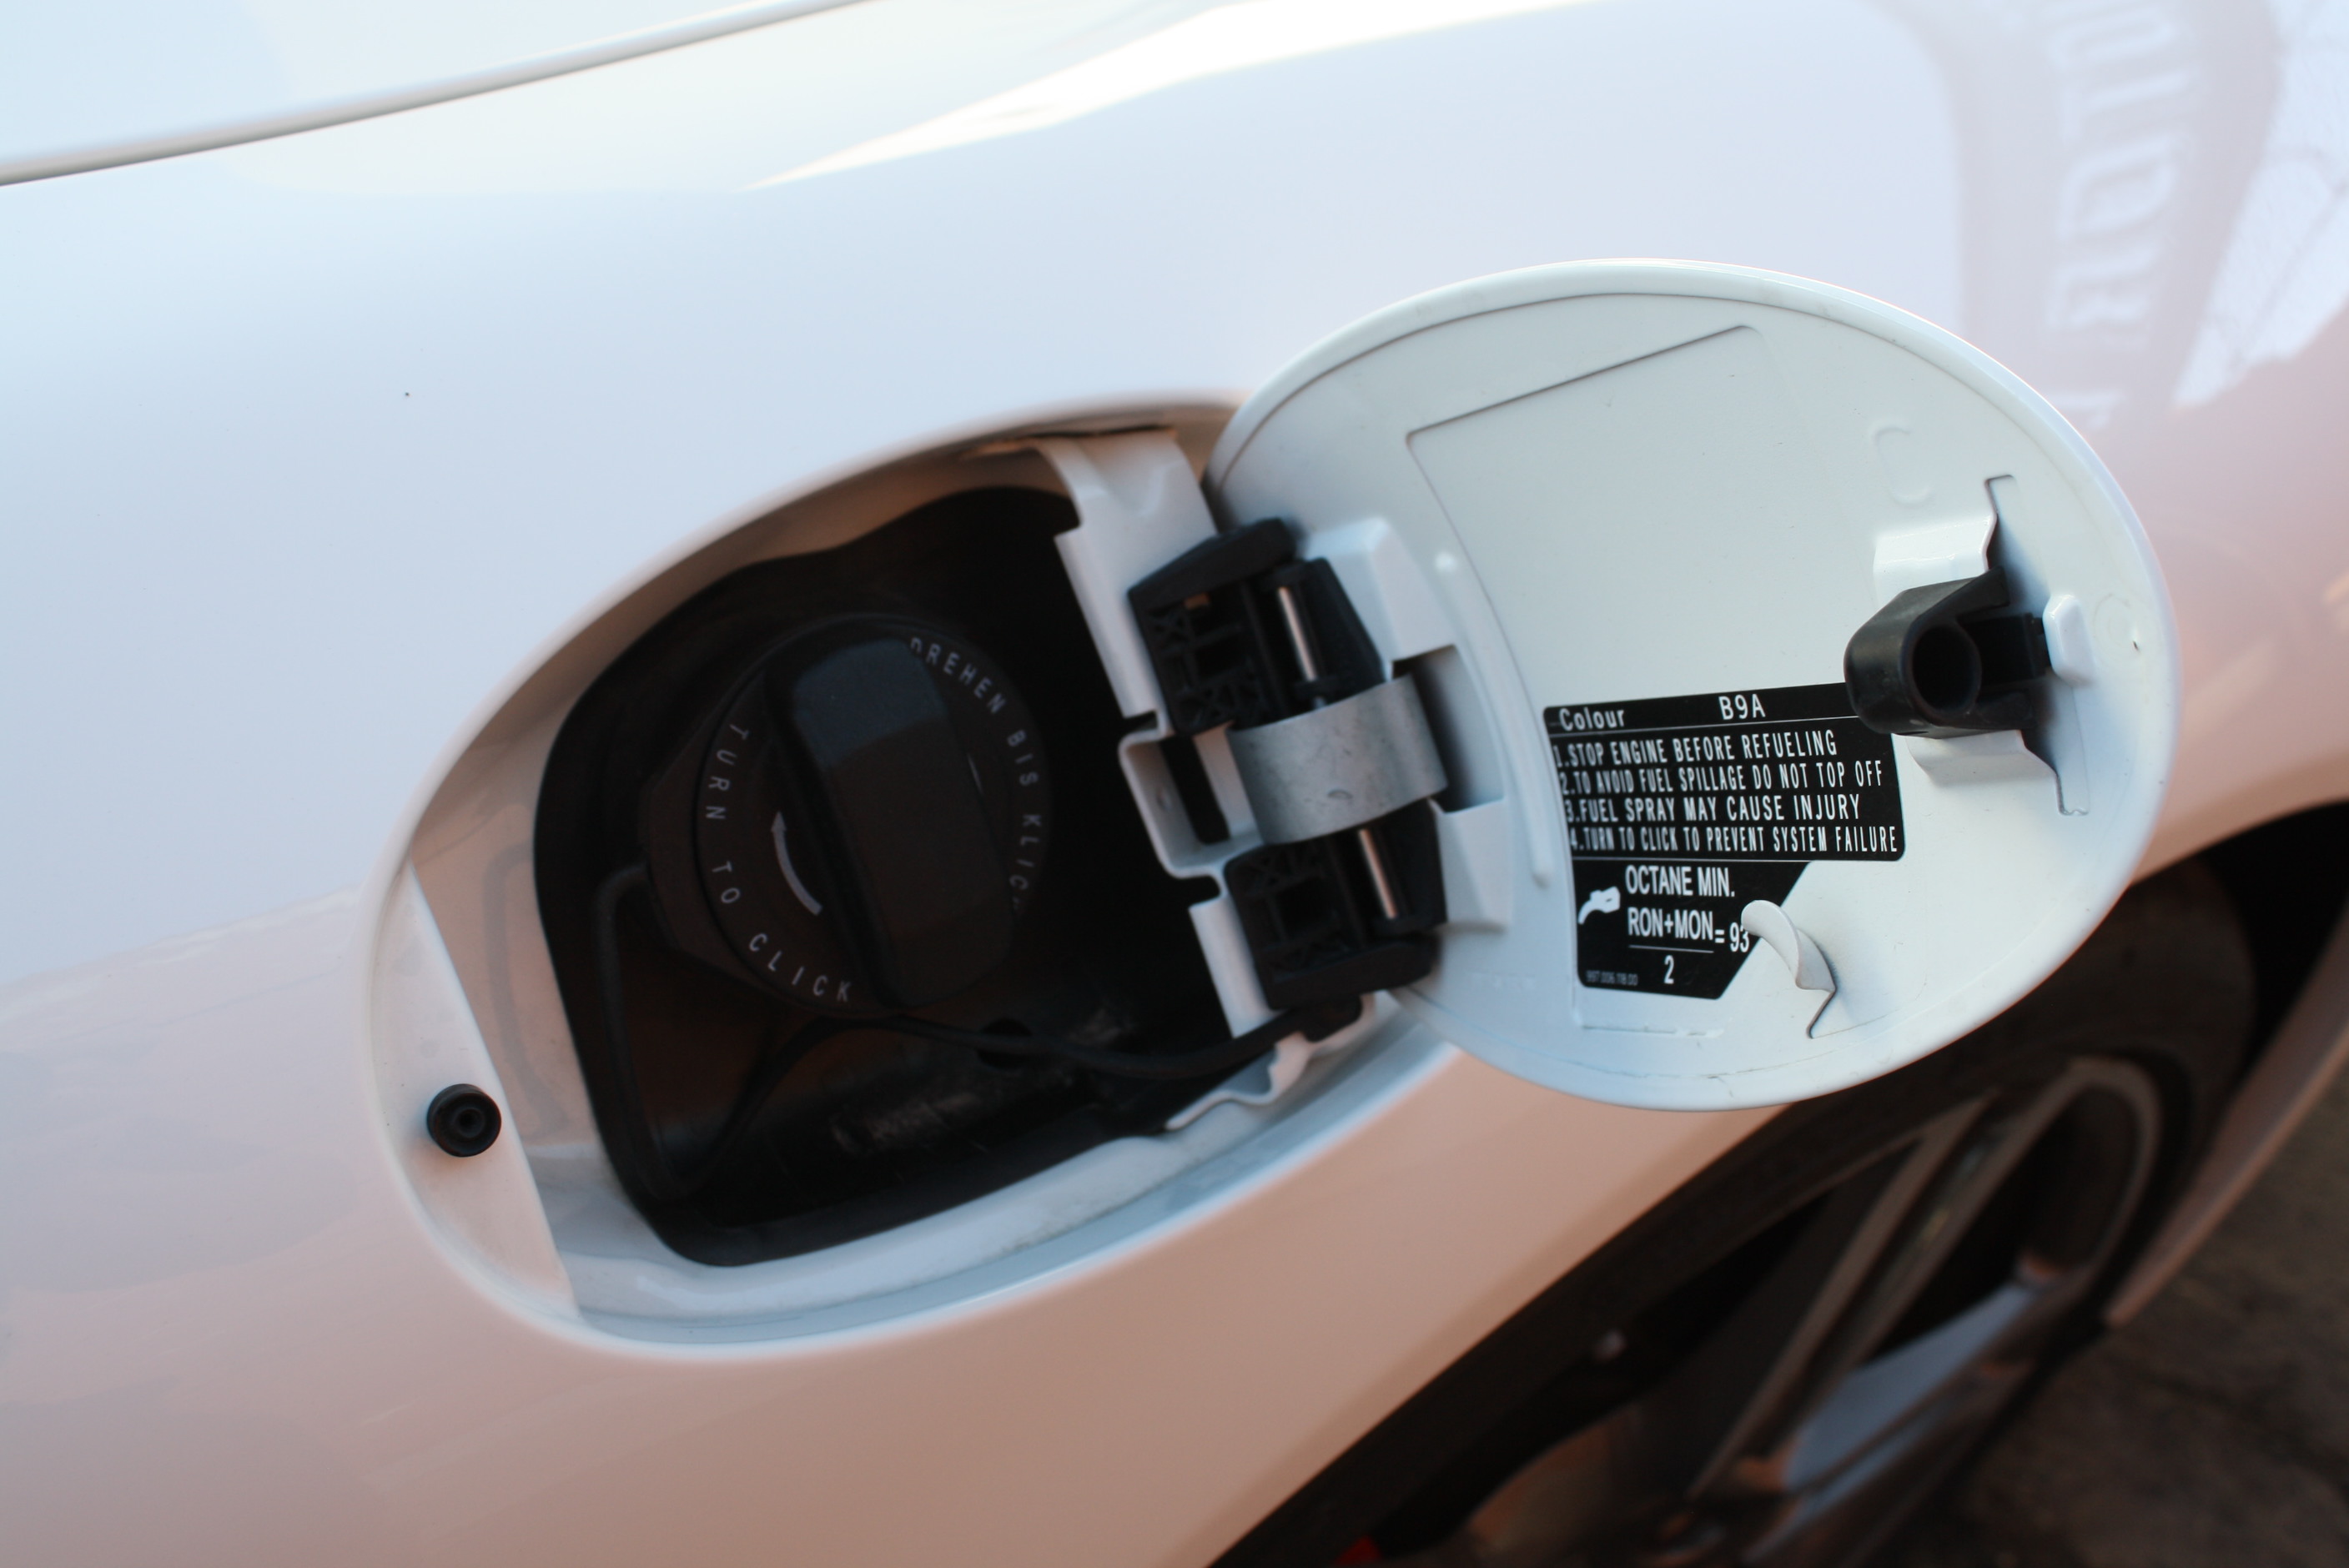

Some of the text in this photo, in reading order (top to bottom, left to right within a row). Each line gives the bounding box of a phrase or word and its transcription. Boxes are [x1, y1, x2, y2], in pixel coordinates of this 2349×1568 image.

[1558, 694, 1766, 731] Colour B9A
[1006, 730, 1040, 787] BIS
[1610, 739, 1667, 766] ENGINE
[1672, 736, 1735, 762] BEFORE
[1742, 729, 1837, 760] REFUELING
[1596, 769, 1634, 794] AVOID
[1639, 768, 1673, 792] FUEL
[1678, 765, 1746, 792] SPILLAGE
[1752, 764, 1772, 790] DO
[1779, 762, 1808, 789] NOT
[1816, 761, 1844, 788] TOP
[1855, 760, 1882, 787] OFF
[1624, 797, 1675, 822] SPRAY
[1683, 797, 1717, 822] MAY
[1726, 795, 1785, 822] CAUSE
[1793, 794, 1859, 821] INJURY
[1618, 827, 1635, 852] TO
[1640, 827, 1678, 852] CLICK
[1683, 827, 1700, 852] TO
[1706, 827, 1764, 852] PREVENT
[1773, 827, 1828, 852] SYSTEM
[1835, 826, 1898, 852] FAILURE
[705, 723, 853, 1003] TURN TO CLICK
[1625, 864, 1735, 897] OCTANE MIN.
[1663, 955, 1674, 984] 2
